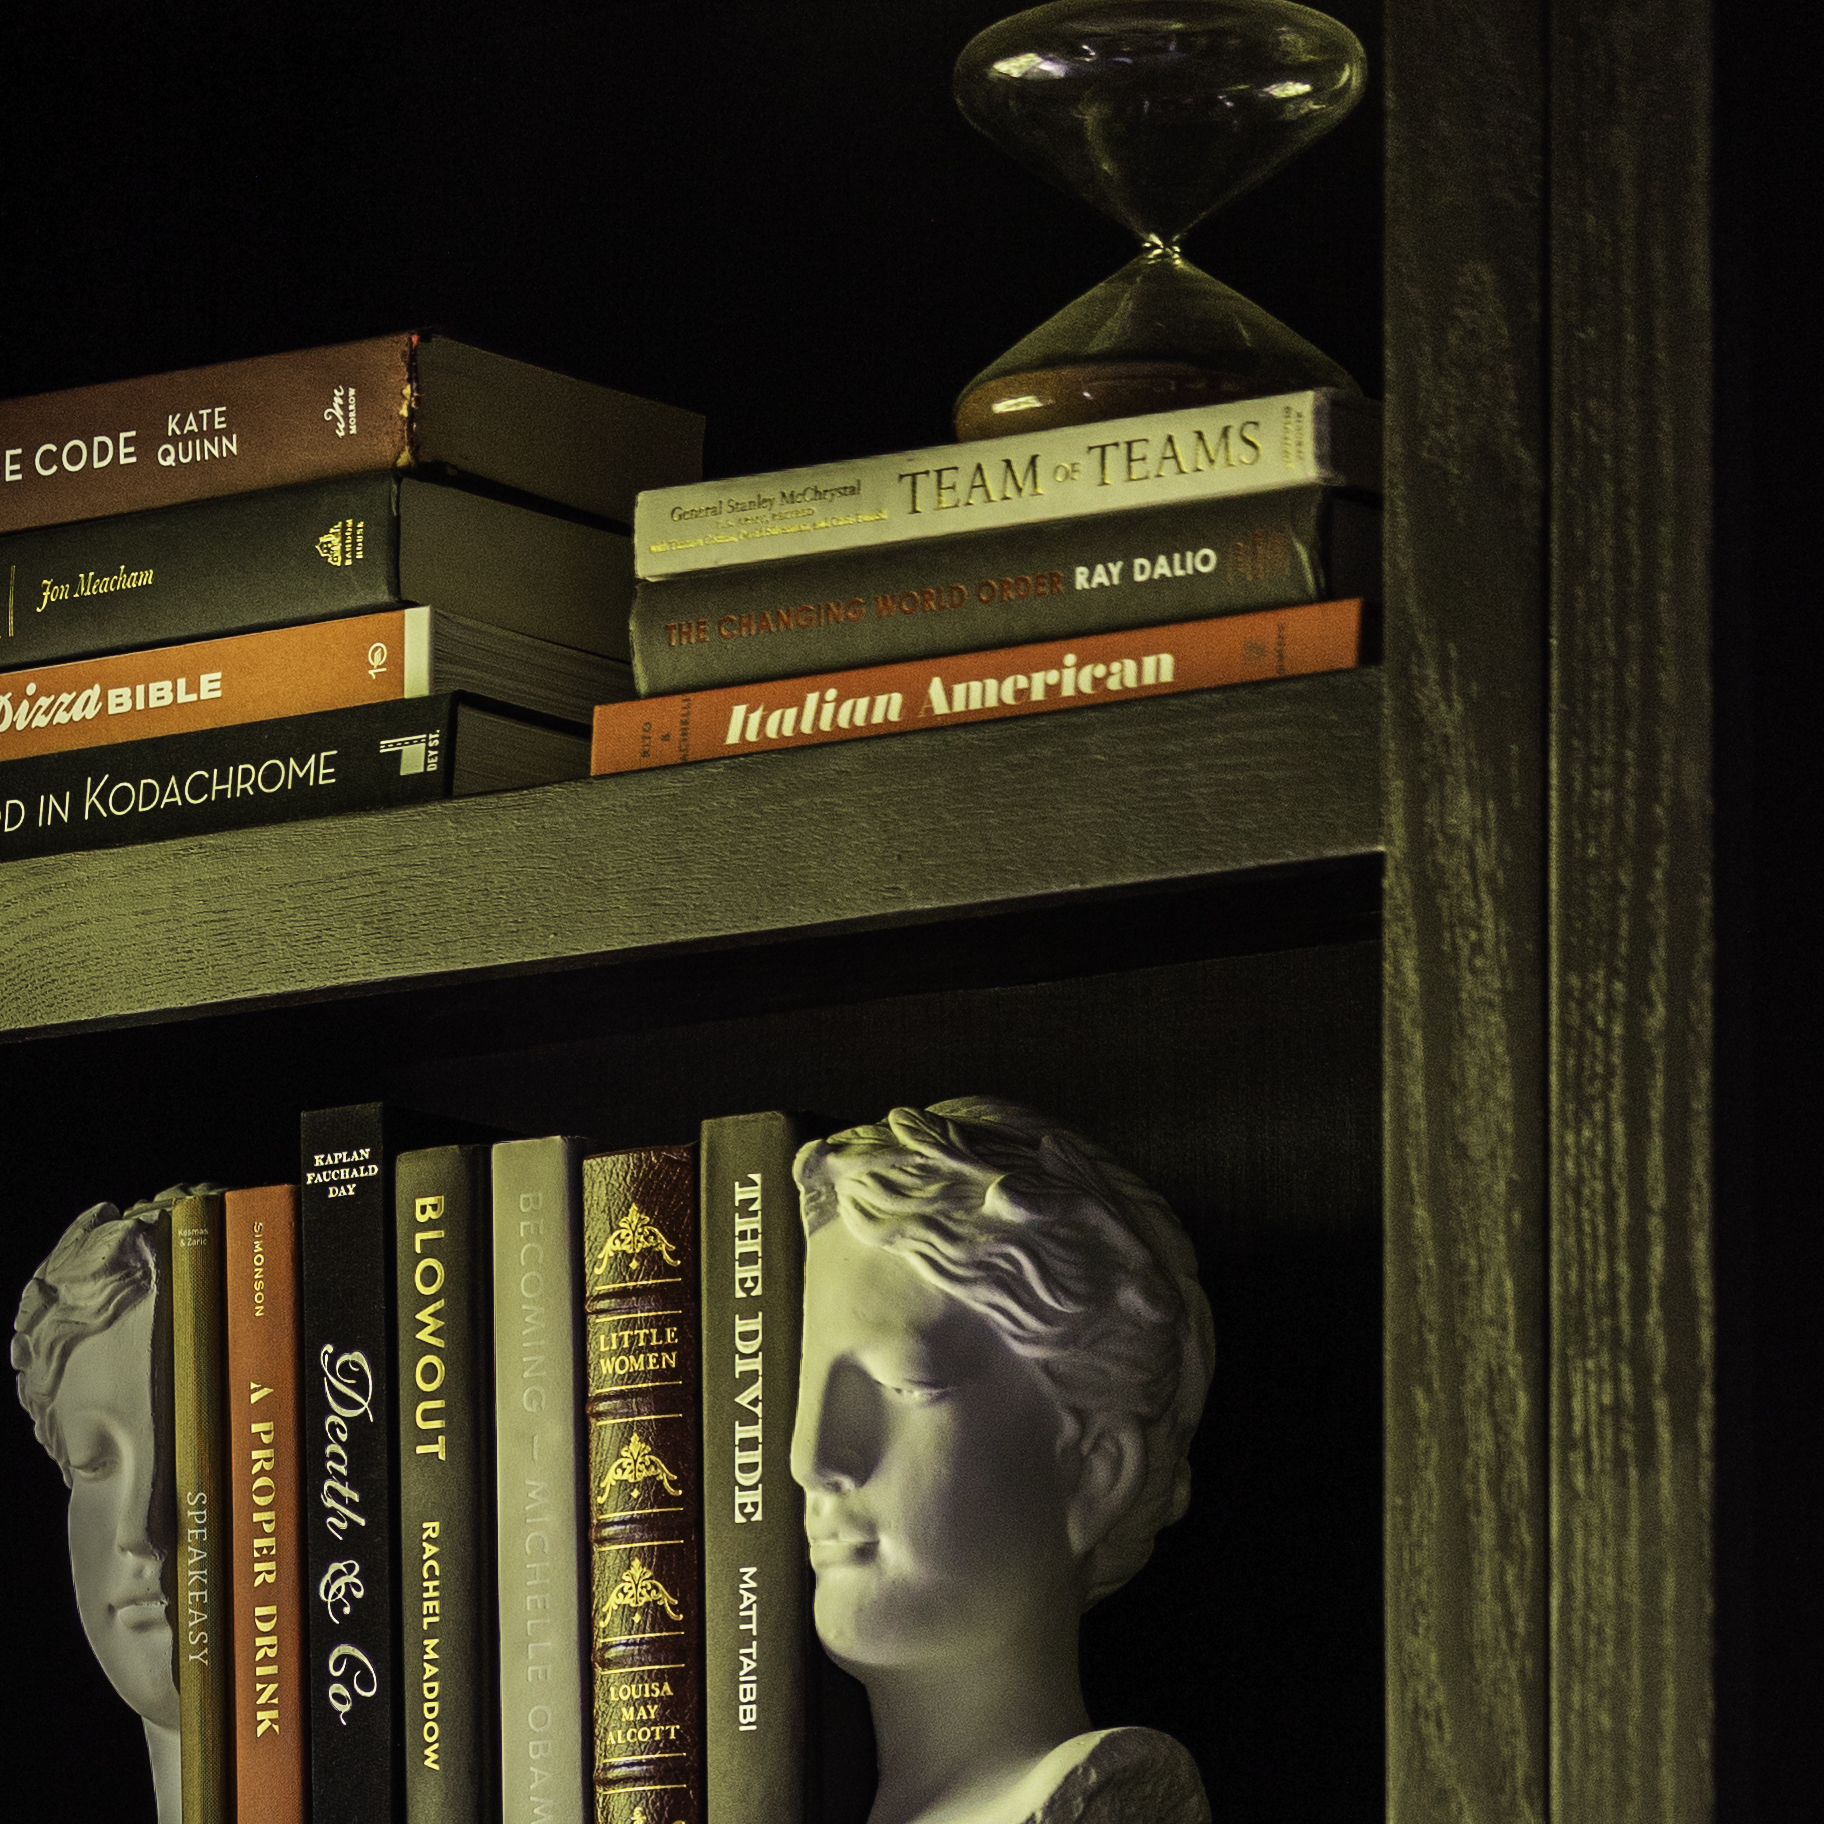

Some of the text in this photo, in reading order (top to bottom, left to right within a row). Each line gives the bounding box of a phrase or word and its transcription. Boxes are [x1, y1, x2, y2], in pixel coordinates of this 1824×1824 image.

[167, 406, 227, 437] KATE
[348, 387, 357, 435] MORROW
[34, 431, 137, 476] CODE
[157, 433, 238, 467] QUINN
[898, 453, 1044, 515] TEAM
[1053, 461, 1081, 483] OF
[1087, 420, 1262, 487] TEAMS
[670, 479, 862, 522] General Stanley McChrystal
[36, 565, 154, 612] Jon Meacham
[1075, 560, 1124, 590] RAY
[1133, 548, 1217, 582] DALIO
[665, 570, 1065, 647] THE CHANGING WORLD ORDER
[108, 671, 222, 715] BIBLE
[723, 653, 1175, 745] Italian American
[426, 729, 441, 772] DEY ST.
[38, 791, 70, 828] IN
[84, 750, 338, 820] KODACHROME
[306, 1164, 379, 1185] FAUCHALD
[314, 1148, 371, 1167] KAPLAN
[328, 1183, 357, 1199] DAY
[253, 1221, 265, 1317] SIMONSON
[519, 1191, 547, 1415] BECOMING
[414, 1194, 446, 1462] BLOWOUT
[599, 1327, 679, 1352] LITTLE
[733, 1173, 763, 1524] THE DIVIDE
[600, 1351, 678, 1375] WOMEN
[319, 1343, 377, 1726] Death & Co
[186, 1491, 208, 1666] SPEAKEASY
[250, 1381, 280, 1738] A PROPER DRINK
[525, 1479, 552, 1683] MICHELLE
[422, 1521, 440, 1771] RACHEL MADDOW
[738, 1566, 757, 1732] MATT TAIBBI
[609, 1682, 674, 1701] LOUISA
[621, 1704, 659, 1721] MAY
[606, 1724, 680, 1745] ALCOTT
